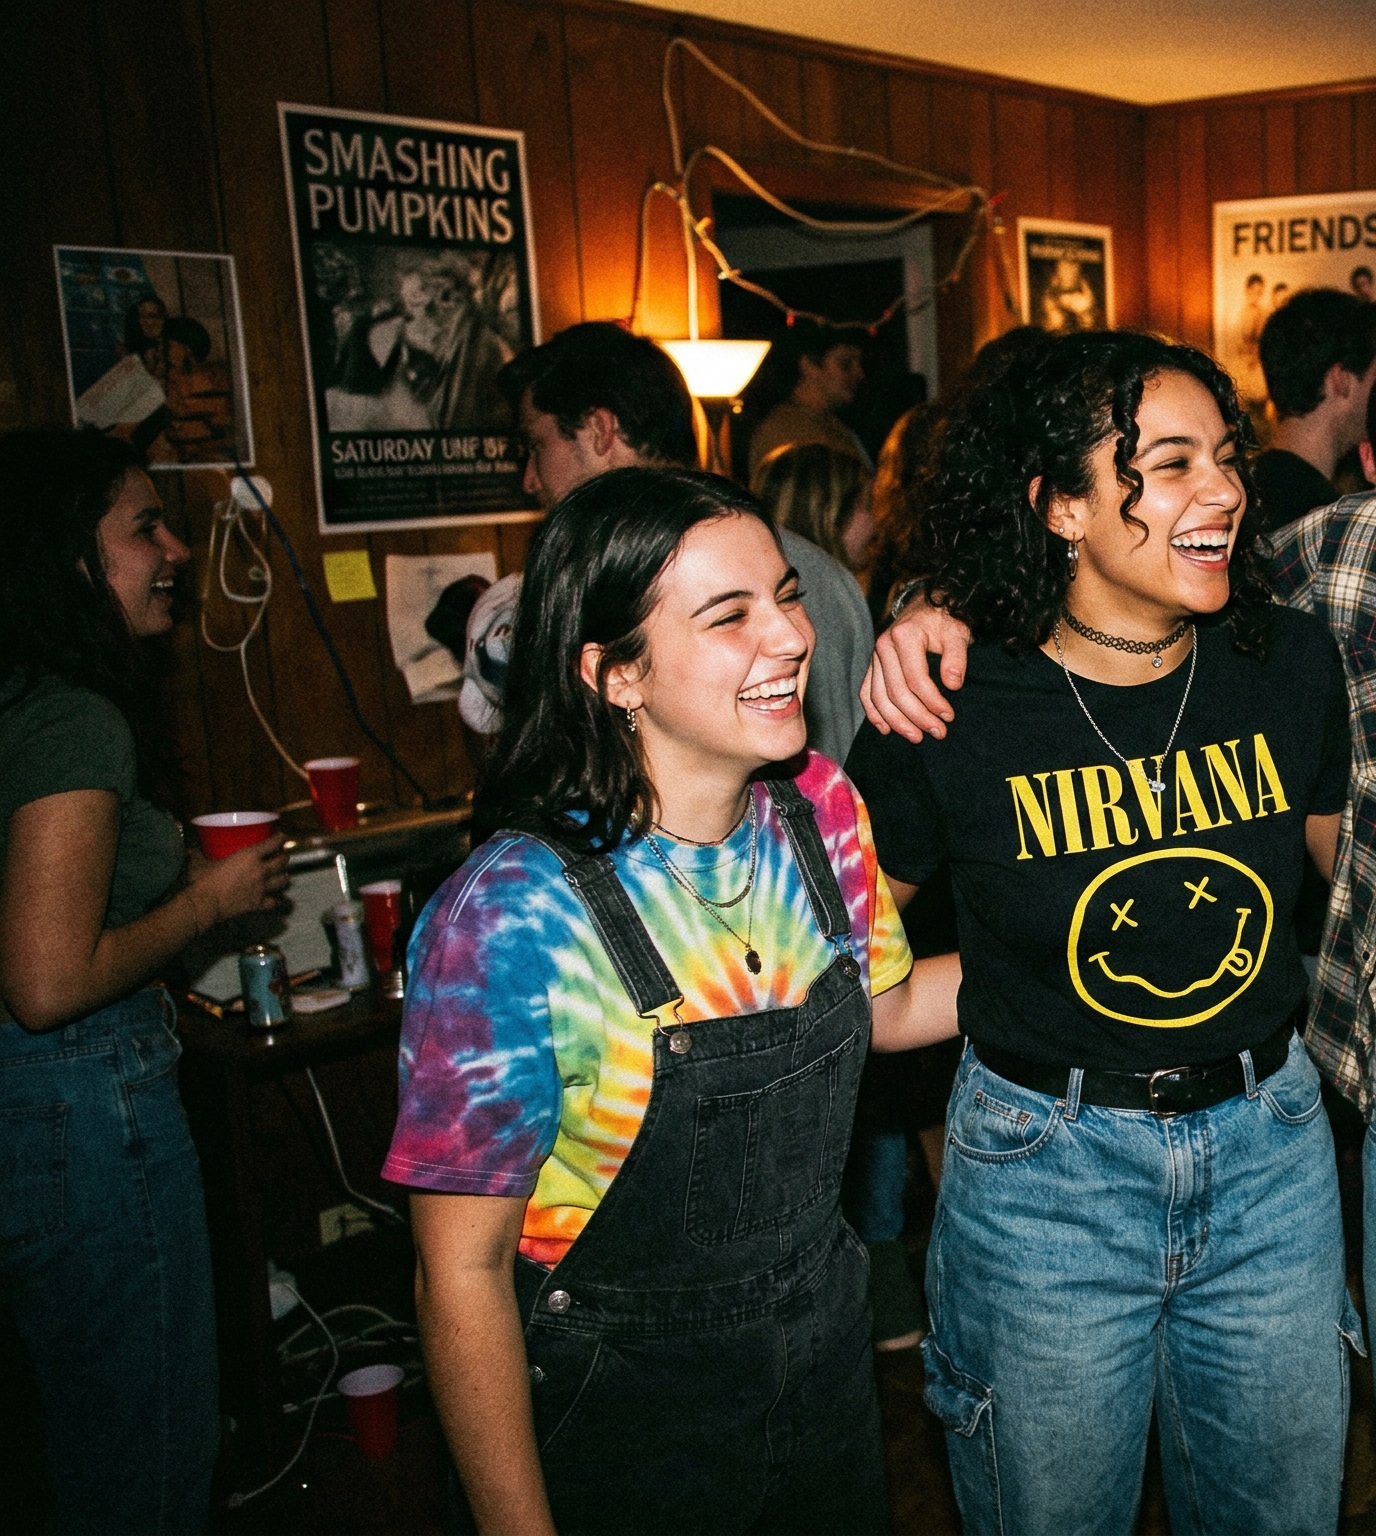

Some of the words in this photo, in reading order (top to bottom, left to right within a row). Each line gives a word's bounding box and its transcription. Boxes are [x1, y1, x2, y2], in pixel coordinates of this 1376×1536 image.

[303, 128, 510, 194] SMASHING
[308, 183, 514, 244] PUMPKINS
[331, 437, 434, 464] SATURDAY
[1005, 733, 1291, 860] NIRVANA
